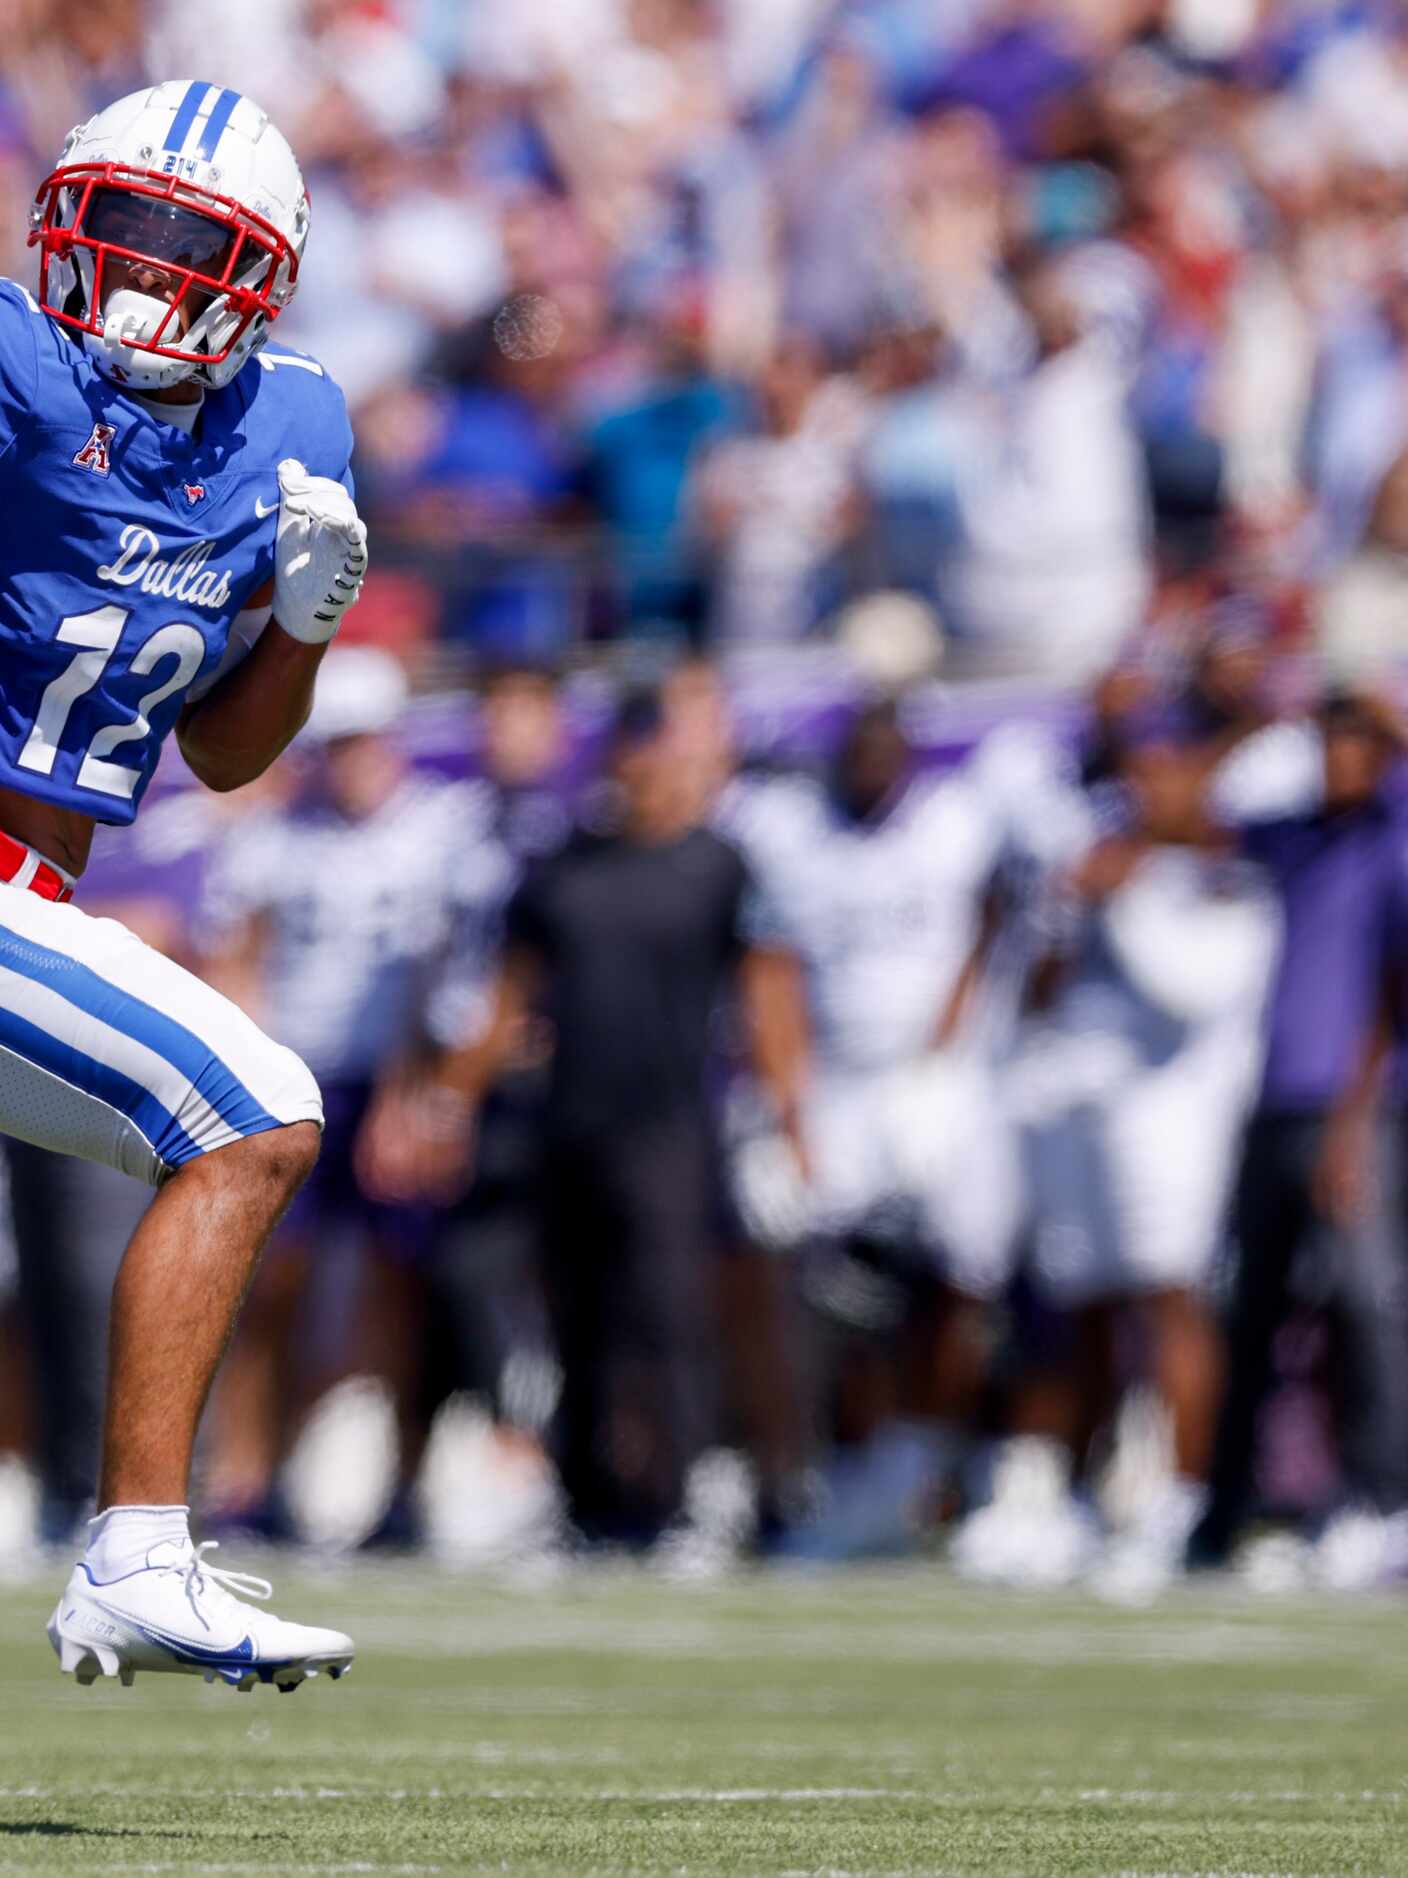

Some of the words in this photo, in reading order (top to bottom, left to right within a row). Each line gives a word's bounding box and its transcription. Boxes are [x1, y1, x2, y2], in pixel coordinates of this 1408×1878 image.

[162, 154, 198, 179] 214
[256, 351, 324, 377] 1
[96, 523, 234, 608] Dallas
[14, 603, 206, 800] 12
